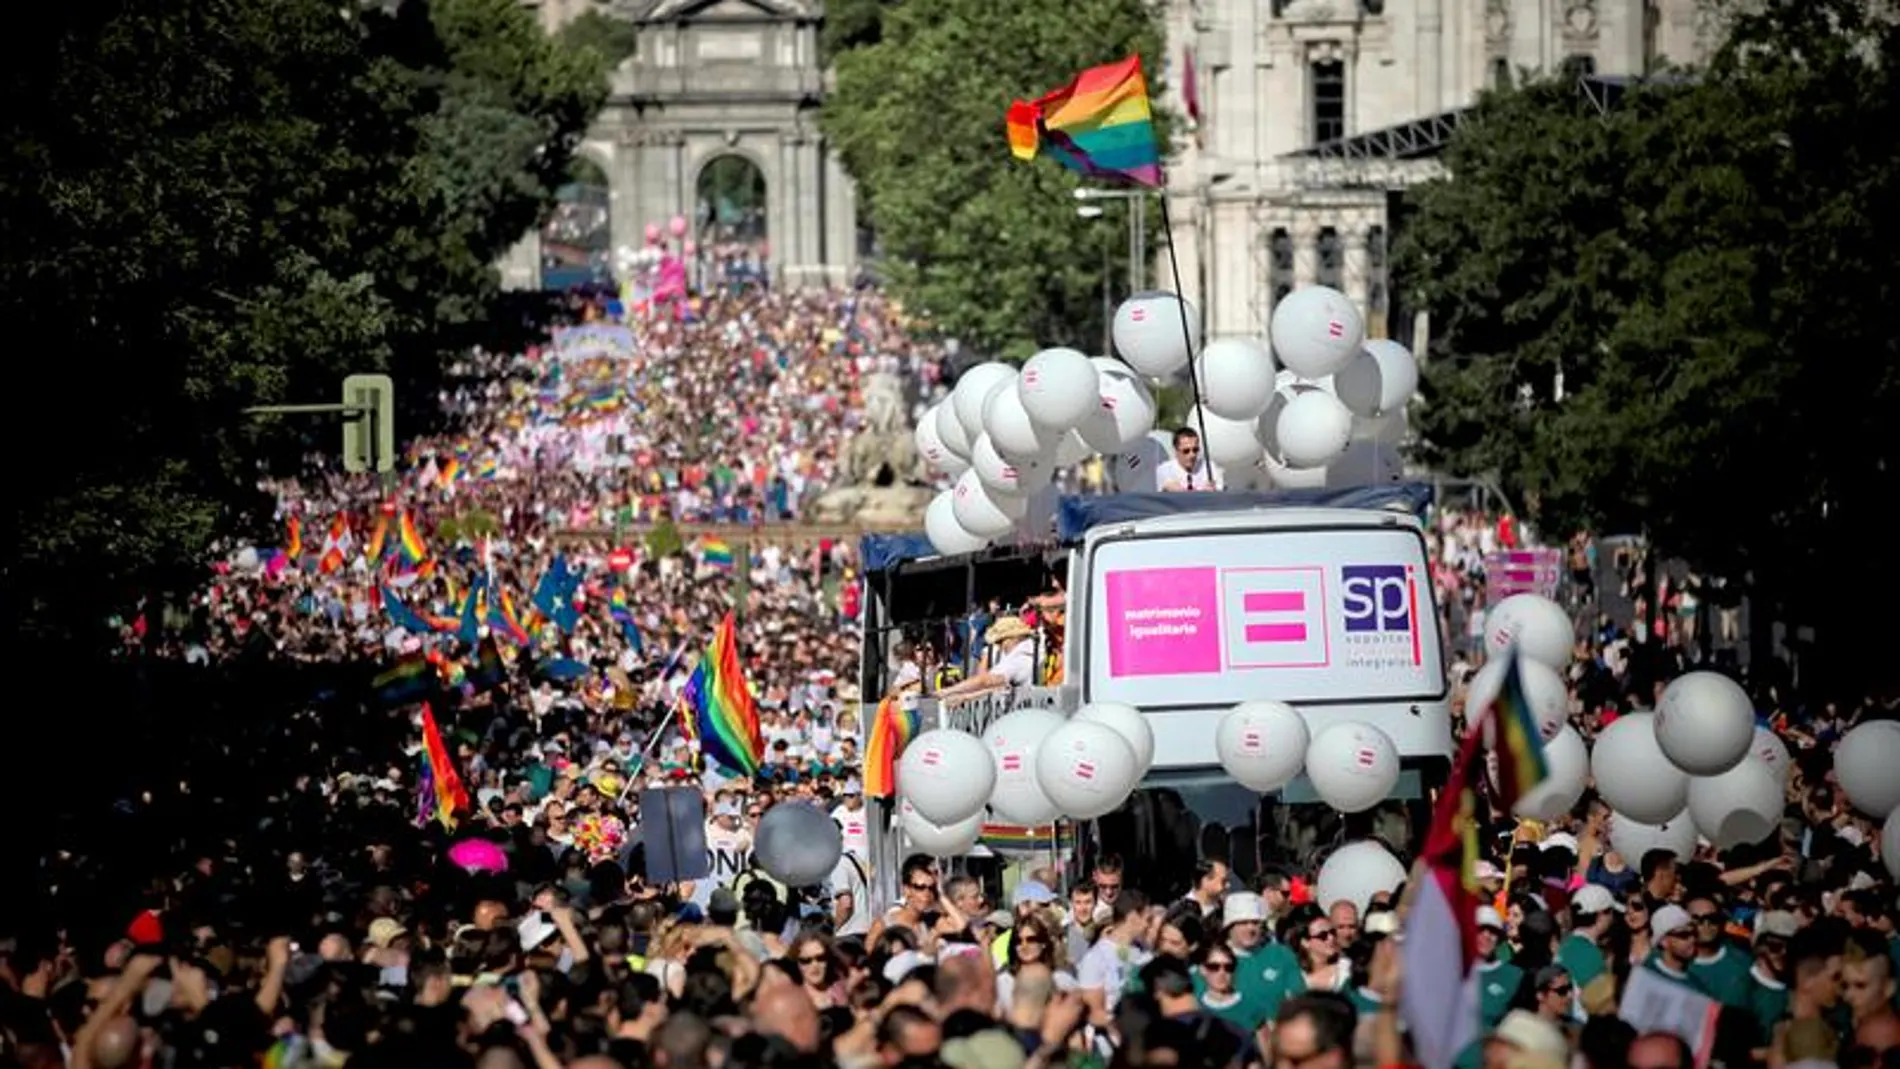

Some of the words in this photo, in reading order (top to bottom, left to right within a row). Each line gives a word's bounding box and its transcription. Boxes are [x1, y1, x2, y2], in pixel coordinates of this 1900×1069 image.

[1124, 605, 1201, 620] matrimonio
[1343, 565, 1421, 666] spi
[1129, 621, 1197, 640] igualitario
